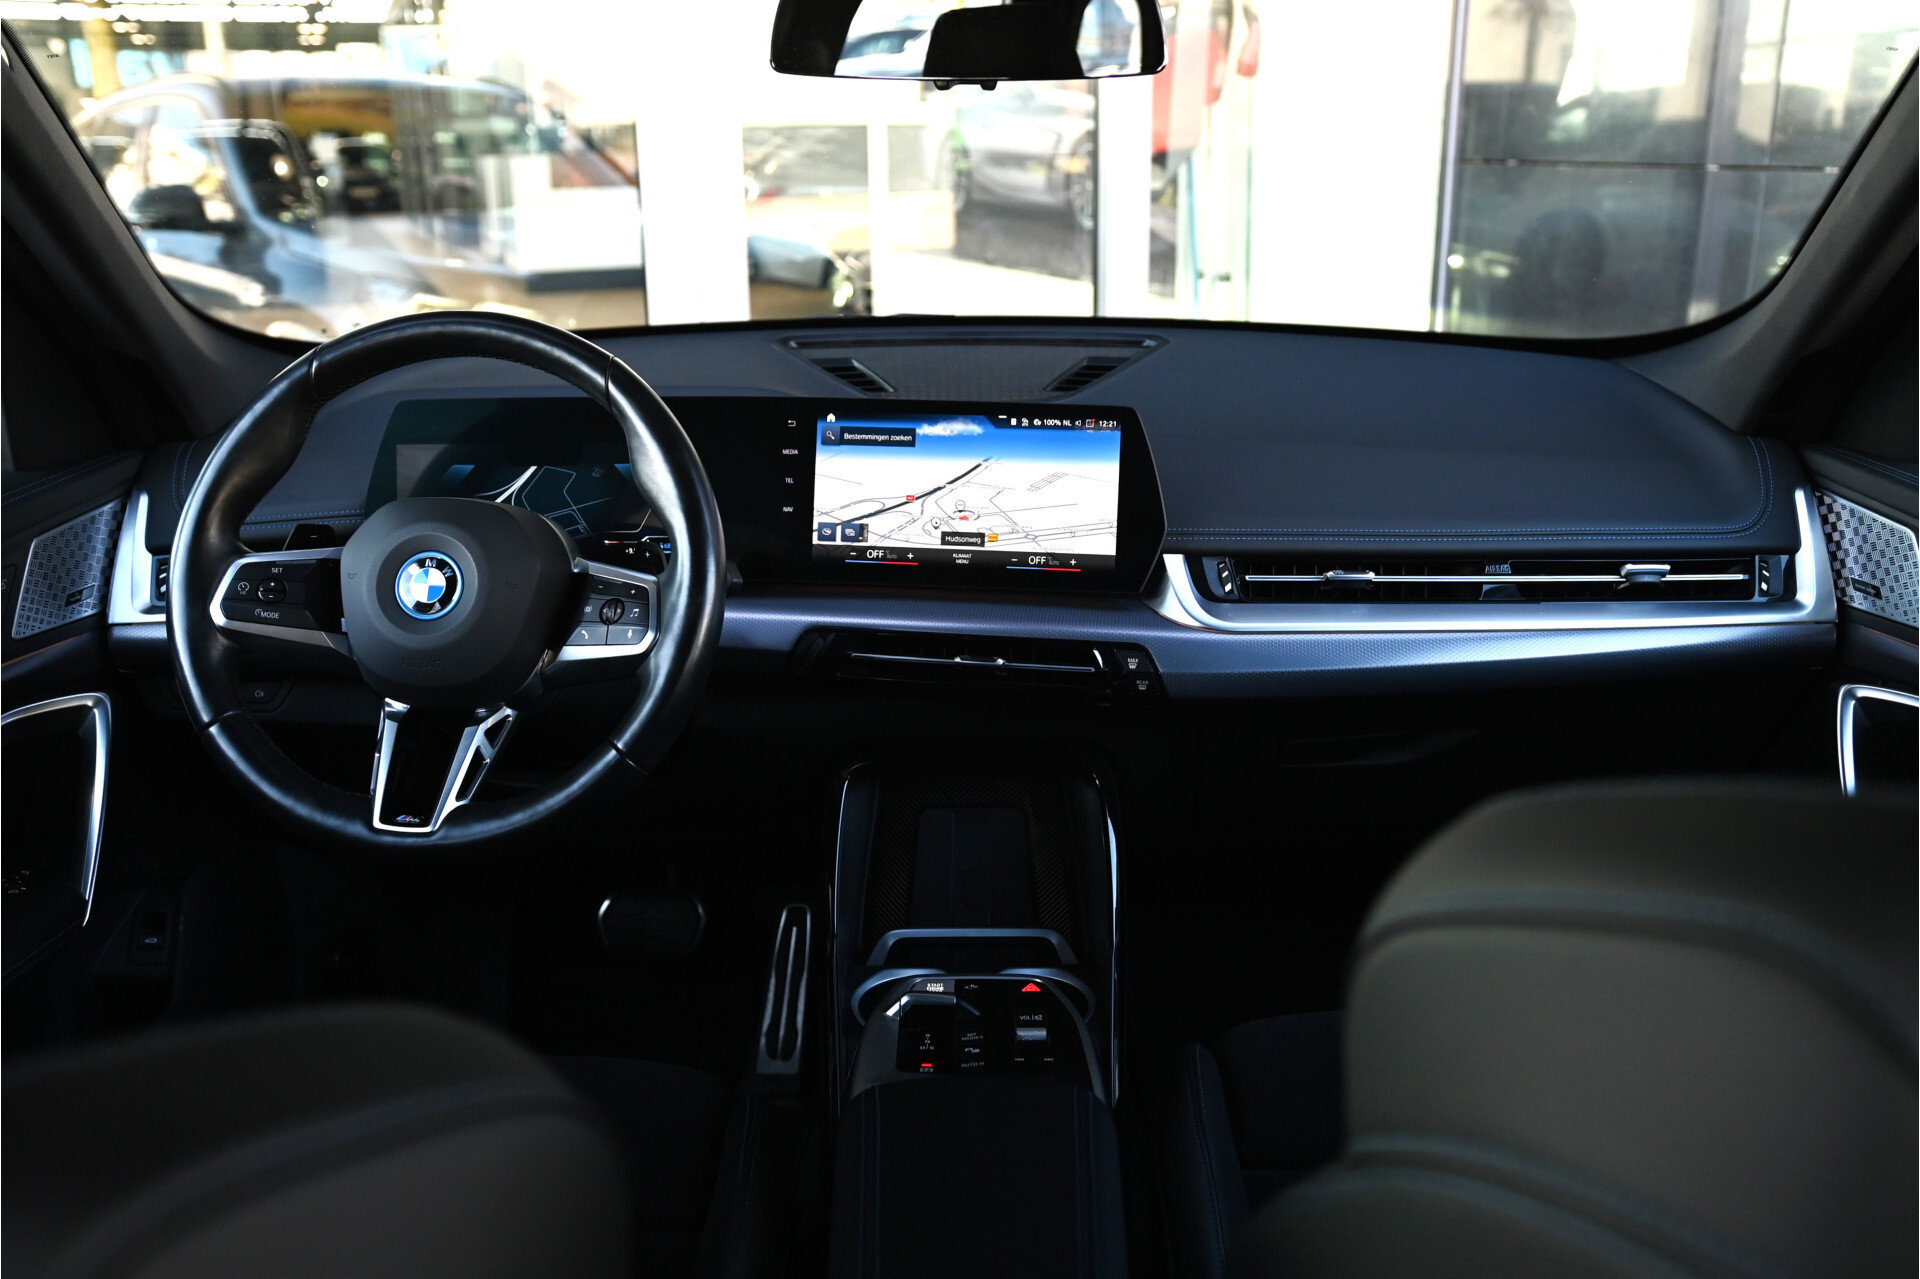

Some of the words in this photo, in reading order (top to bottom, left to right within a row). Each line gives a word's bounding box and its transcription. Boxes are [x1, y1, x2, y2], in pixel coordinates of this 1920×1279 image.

[844, 433, 889, 442] Bestemmingen
[945, 535, 982, 545] Hudsonweg
[866, 549, 884, 559] OFF
[1028, 555, 1047, 565] OFF
[260, 611, 280, 619] MODE
